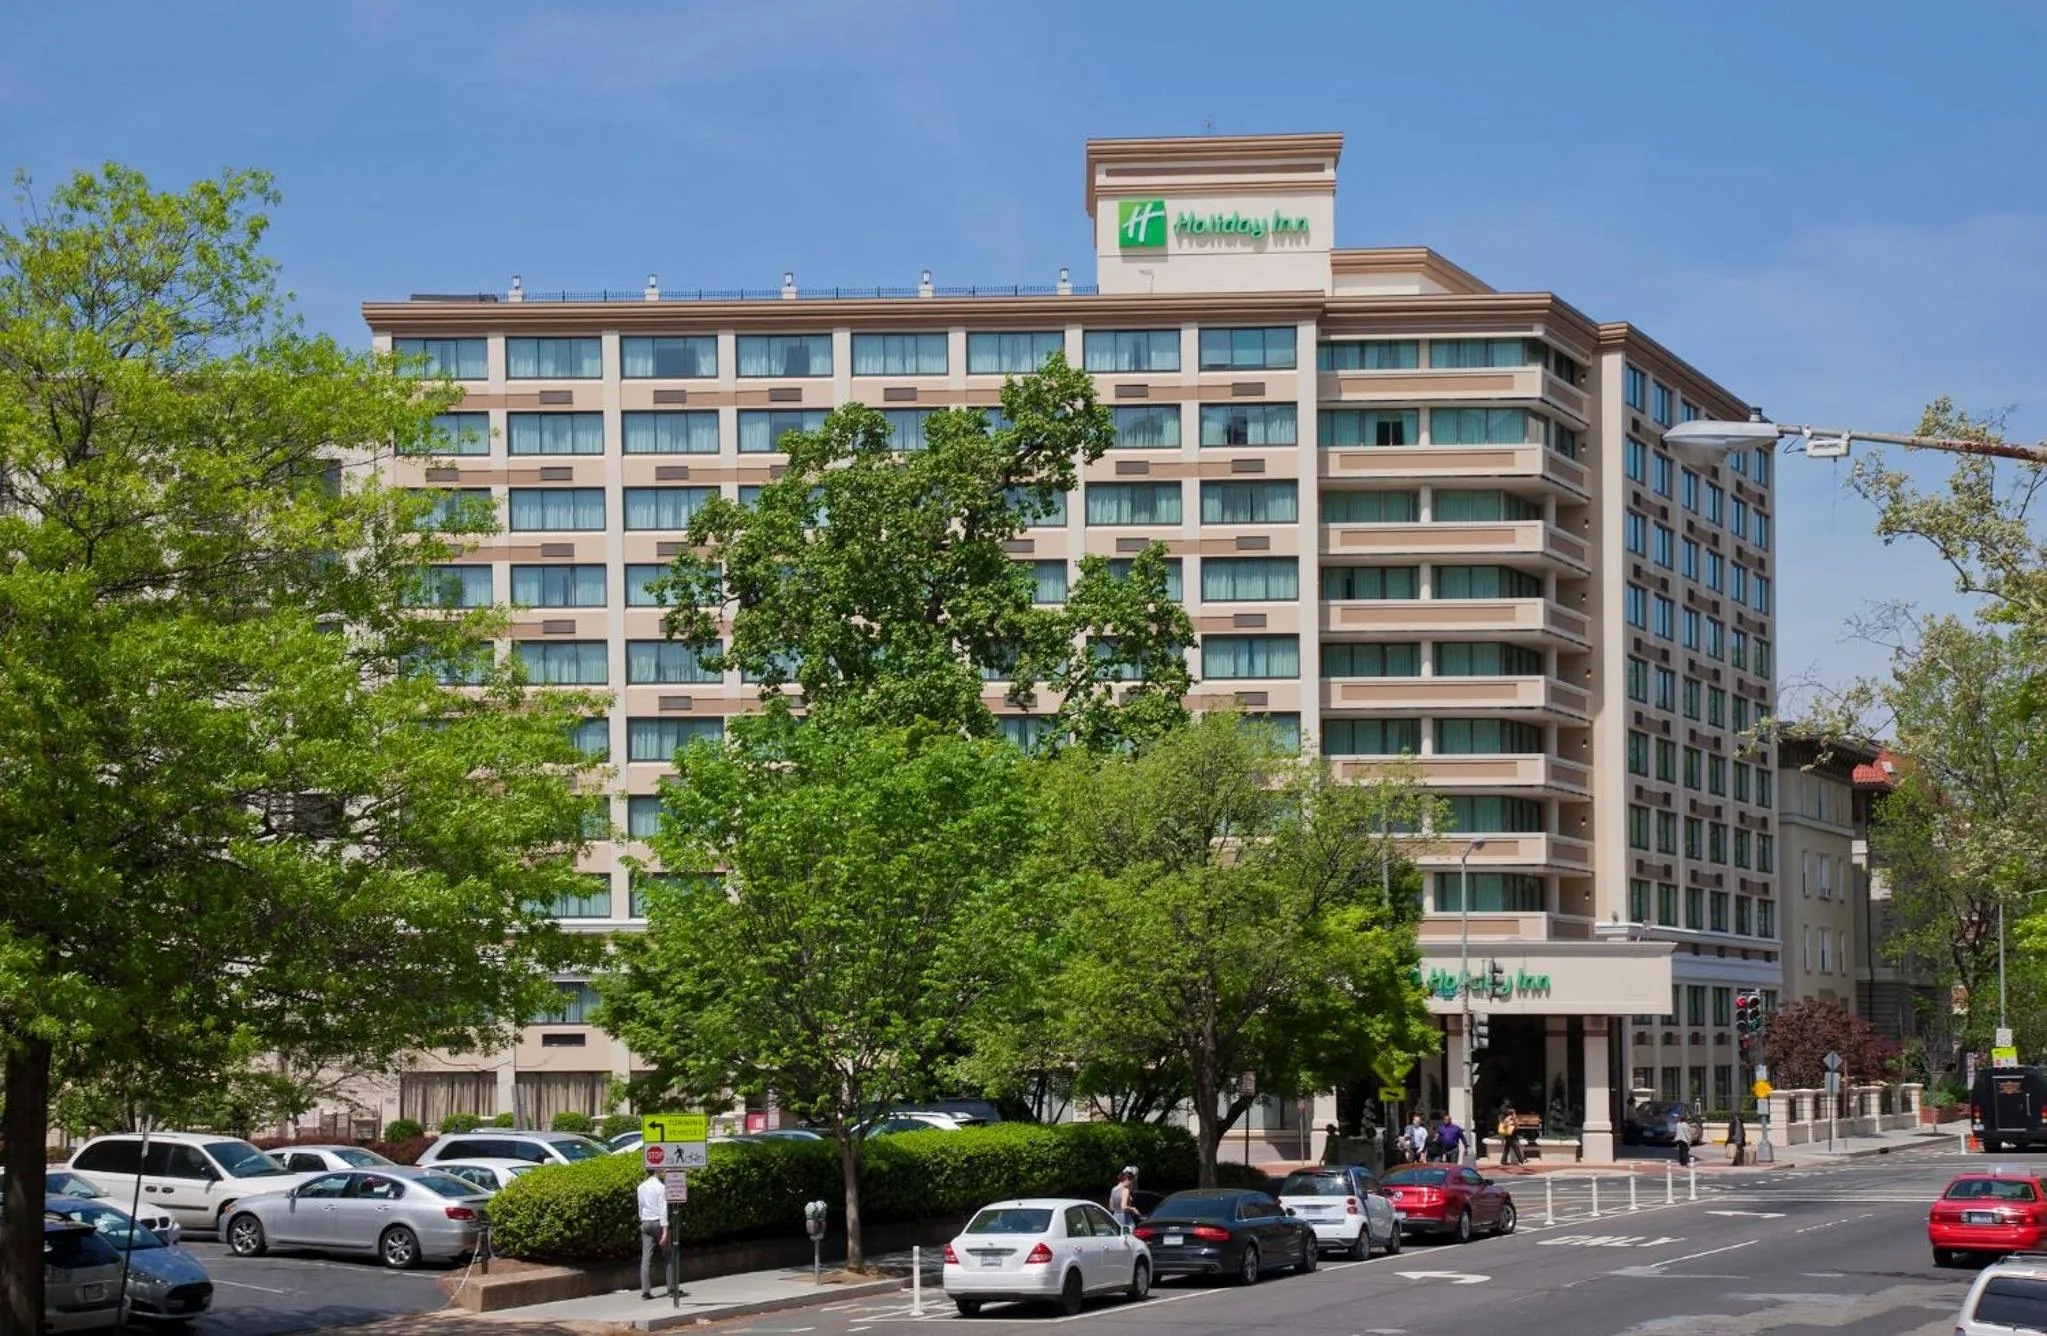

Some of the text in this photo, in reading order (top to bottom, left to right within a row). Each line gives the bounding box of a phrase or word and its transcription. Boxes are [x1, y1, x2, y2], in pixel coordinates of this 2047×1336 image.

[1174, 209, 1310, 239] Holiday Inn
[1427, 967, 1550, 996] Holdy Inn
[647, 1150, 665, 1160] STOP
[1536, 1235, 1689, 1247] ONLY
